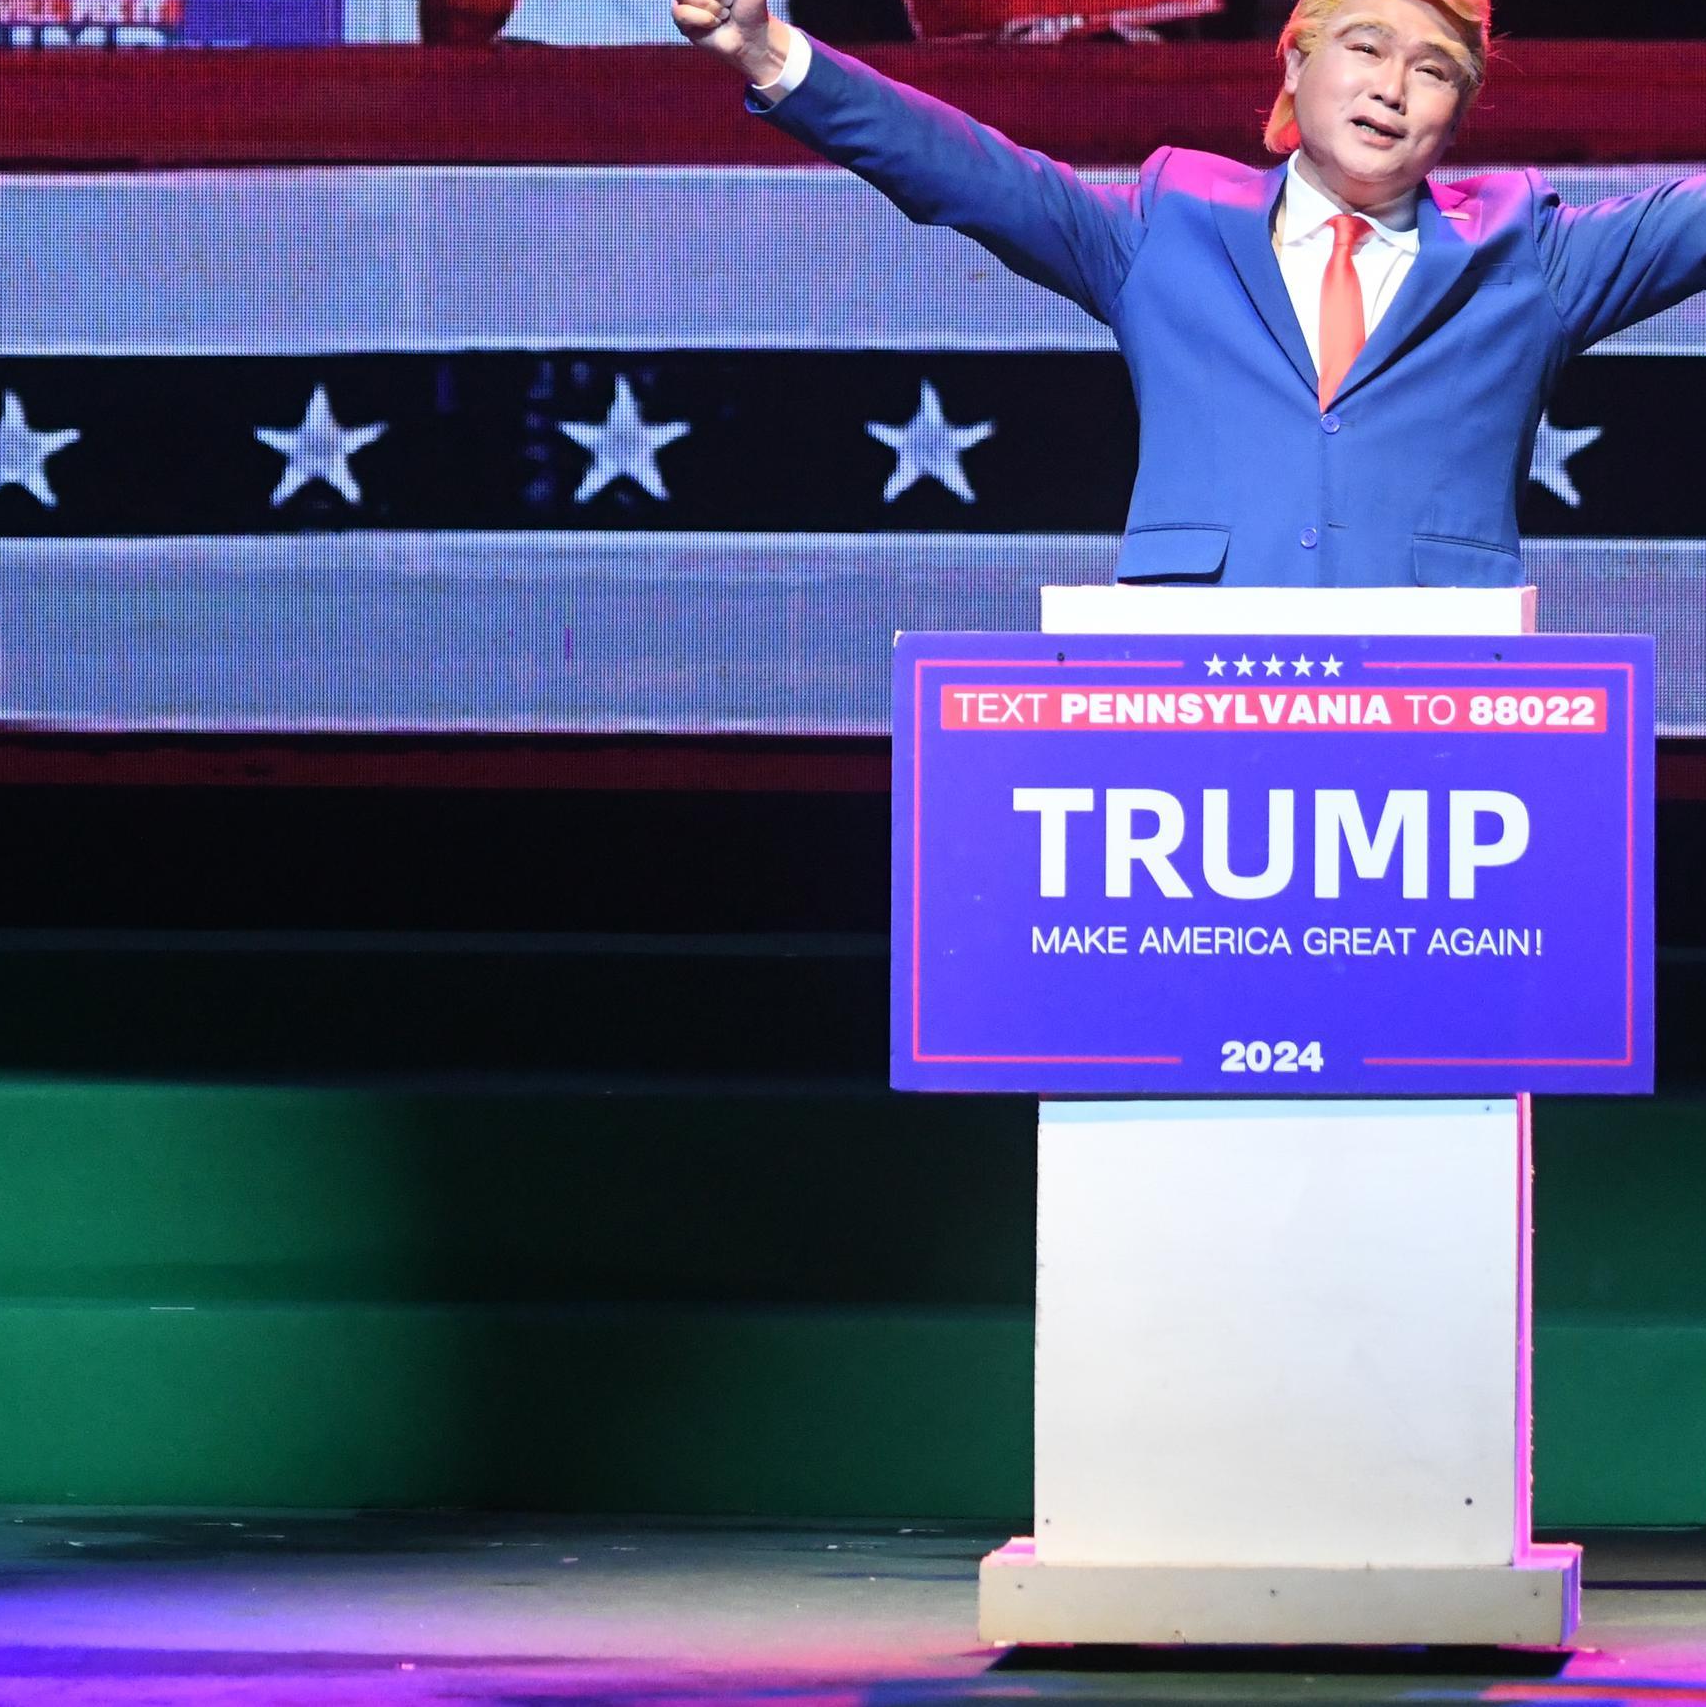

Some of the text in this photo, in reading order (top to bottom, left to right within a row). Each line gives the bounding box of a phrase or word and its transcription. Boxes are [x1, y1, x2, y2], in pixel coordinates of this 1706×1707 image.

[953, 693, 1595, 727] TEXT PENNSYLVANIA TO 88022
[1012, 787, 1530, 900] TRUMP
[1031, 925, 1543, 958] MAKE AMERICA GREAT AGAIN!
[1220, 1040, 1324, 1074] 2024
